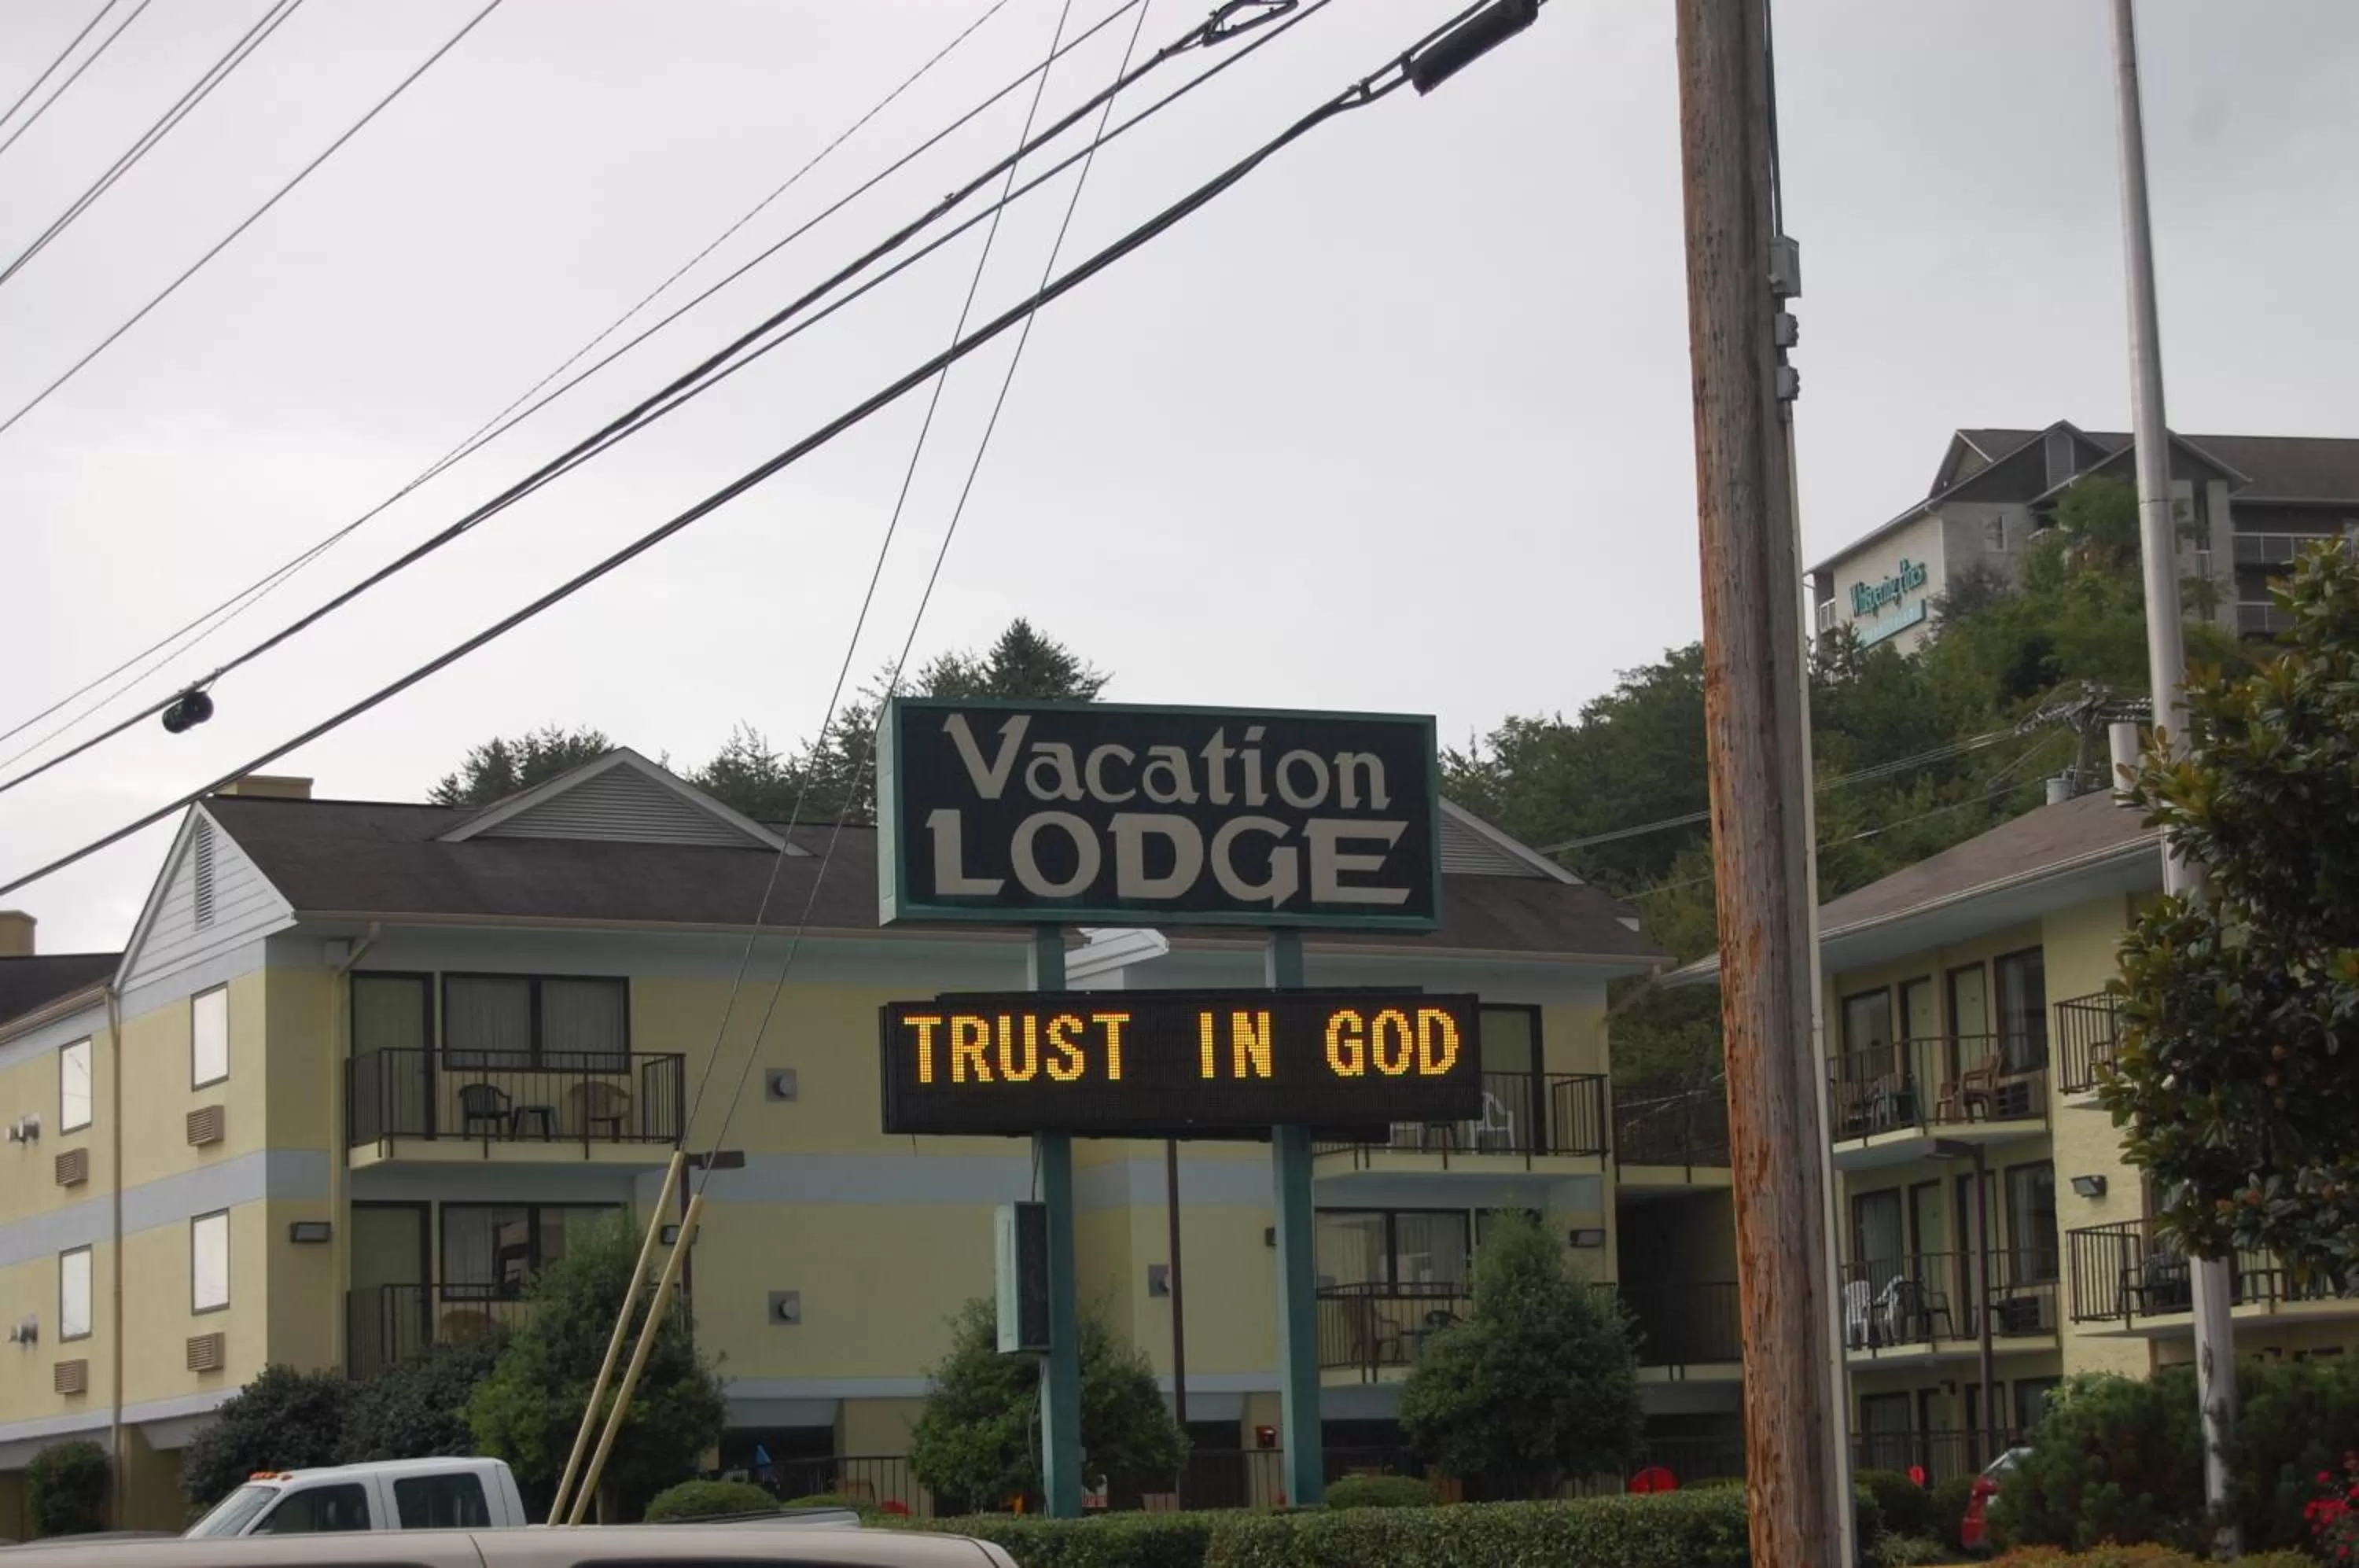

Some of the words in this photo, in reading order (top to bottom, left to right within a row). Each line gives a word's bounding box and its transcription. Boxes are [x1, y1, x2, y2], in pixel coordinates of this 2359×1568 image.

[943, 713, 1392, 810] Vacation
[926, 809, 1411, 908] LODGE
[903, 1012, 1130, 1083] TRUST
[1199, 1010, 1272, 1079] IN
[1325, 1008, 1459, 1077] GOD
